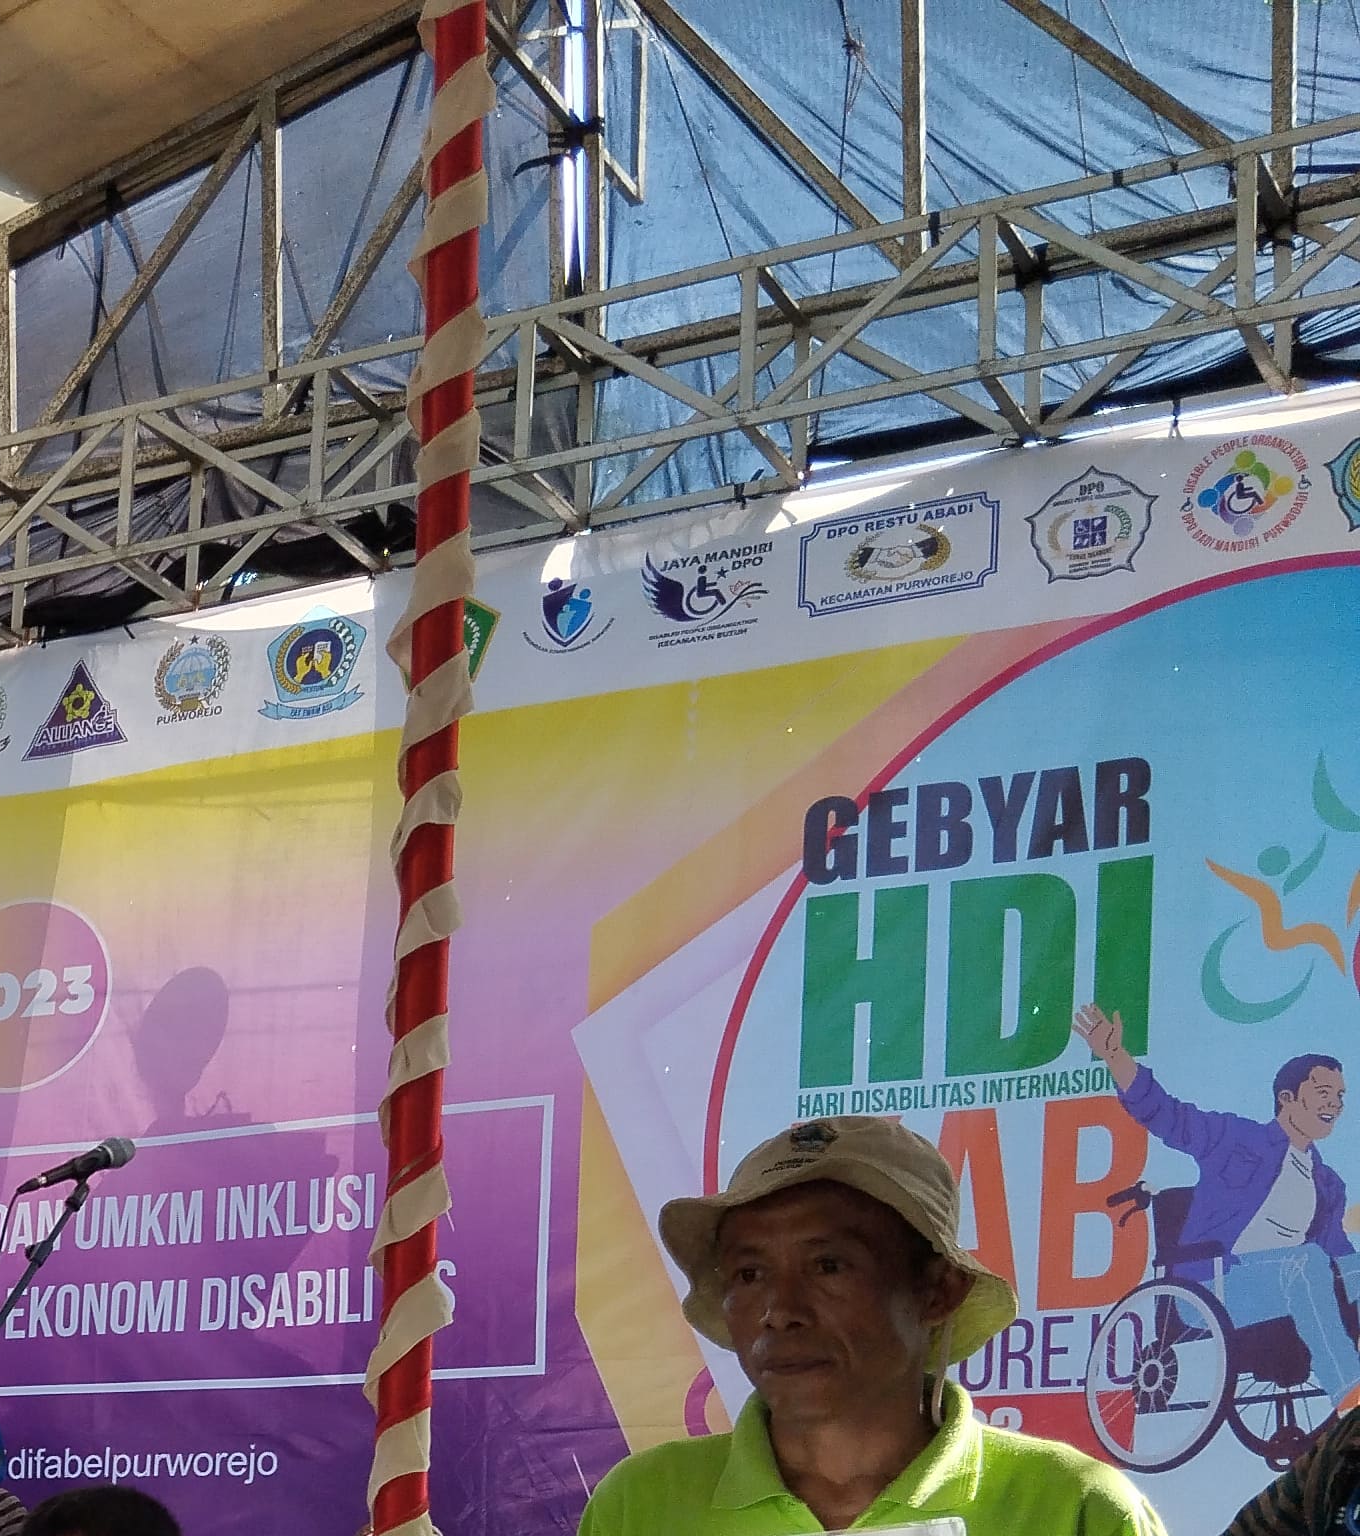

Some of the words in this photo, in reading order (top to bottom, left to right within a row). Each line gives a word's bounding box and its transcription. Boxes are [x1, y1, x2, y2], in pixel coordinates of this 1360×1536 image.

[1210, 435, 1249, 460] PEOPLE
[1080, 481, 1105, 496] DPO
[827, 524, 859, 540] DPO
[864, 512, 918, 532] RESTU
[923, 502, 973, 521] ABADI
[660, 557, 701, 572] JAYA
[705, 541, 773, 564] MANDIRI
[731, 556, 763, 571] DPO
[820, 585, 893, 606] KECAMATAN
[895, 570, 973, 592] PURWOREJO
[156, 706, 223, 725] PURWOREJO
[802, 756, 1153, 886] GEBYAR
[799, 853, 1155, 1089] HDI
[797, 1091, 845, 1118] HARI
[851, 1081, 976, 1114] DISABILITAS
[982, 1065, 1118, 1104] INTERNASION
[74, 1189, 204, 1251] UMKM
[214, 1173, 376, 1242] INKLUSI
[890, 1095, 1153, 1313] AB
[4, 1279, 188, 1340] EKONOMI
[200, 1259, 457, 1332] DISABILIS
